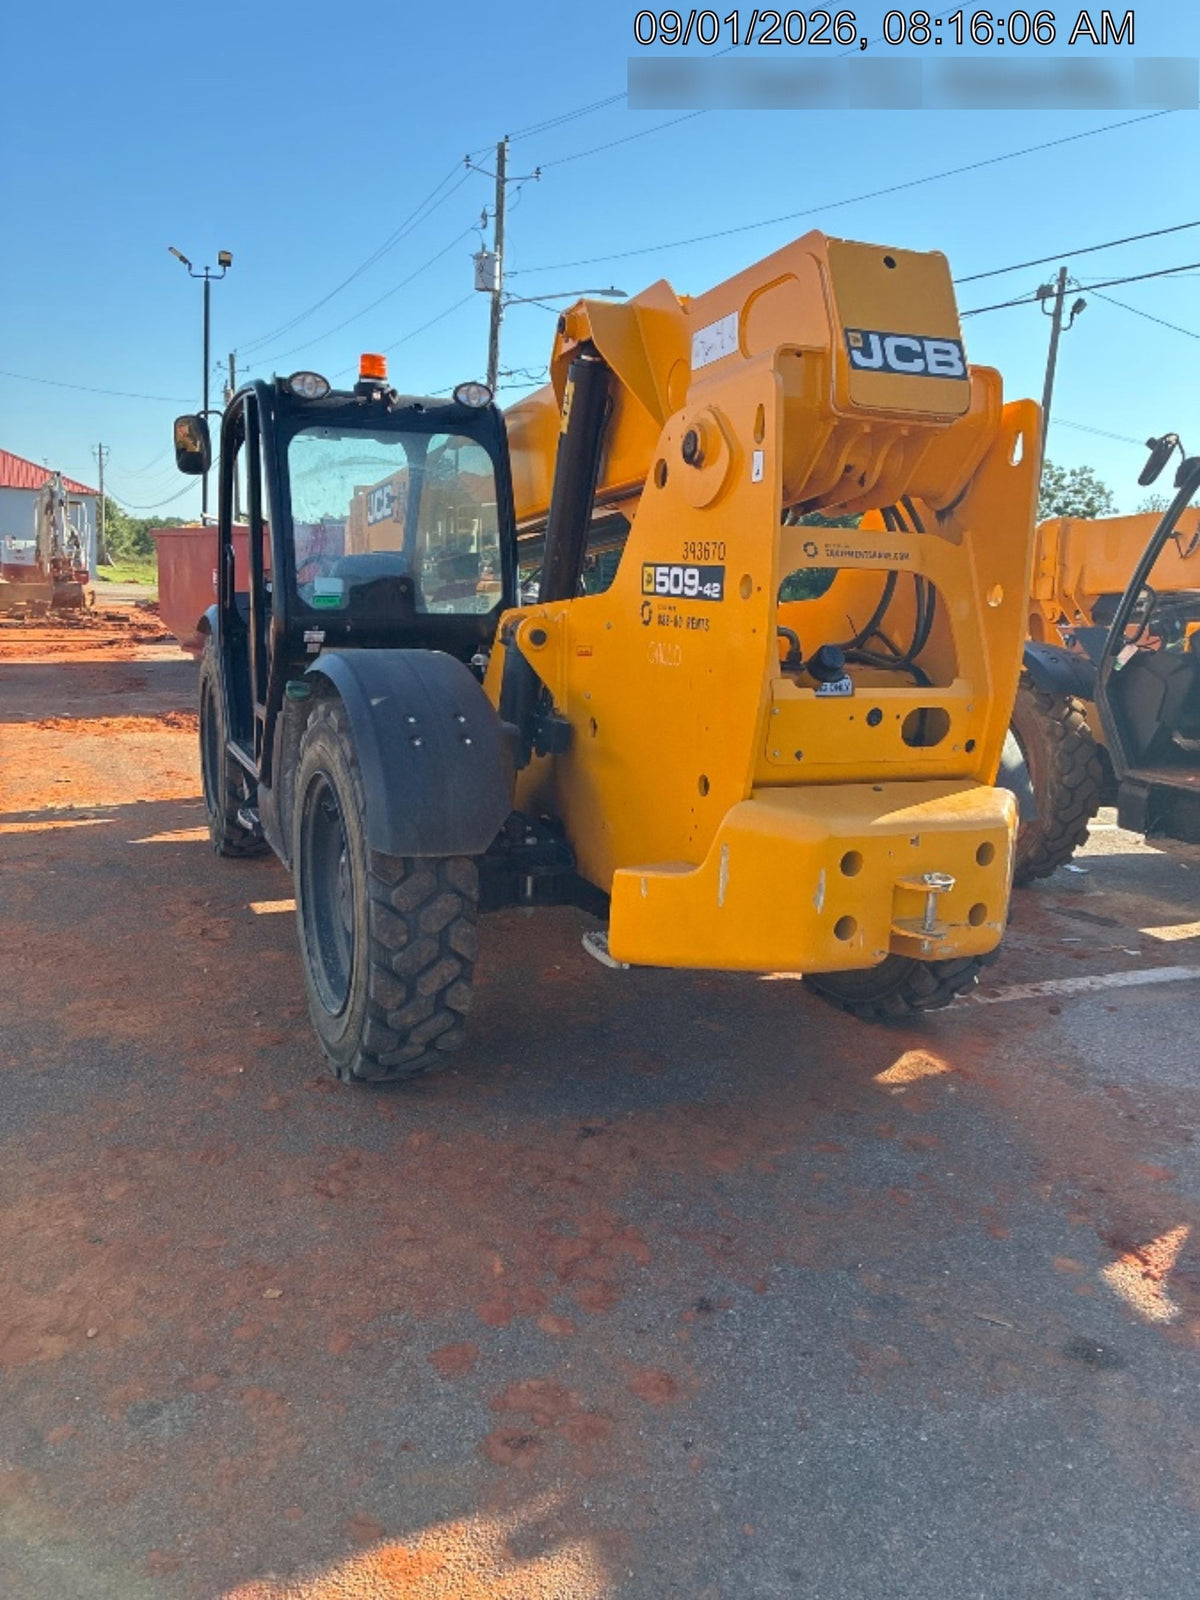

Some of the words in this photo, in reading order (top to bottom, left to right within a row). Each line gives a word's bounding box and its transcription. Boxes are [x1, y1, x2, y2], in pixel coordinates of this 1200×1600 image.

[851, 333, 965, 376] JCB
[682, 541, 726, 561] 393670
[655, 566, 721, 598] 509-42
